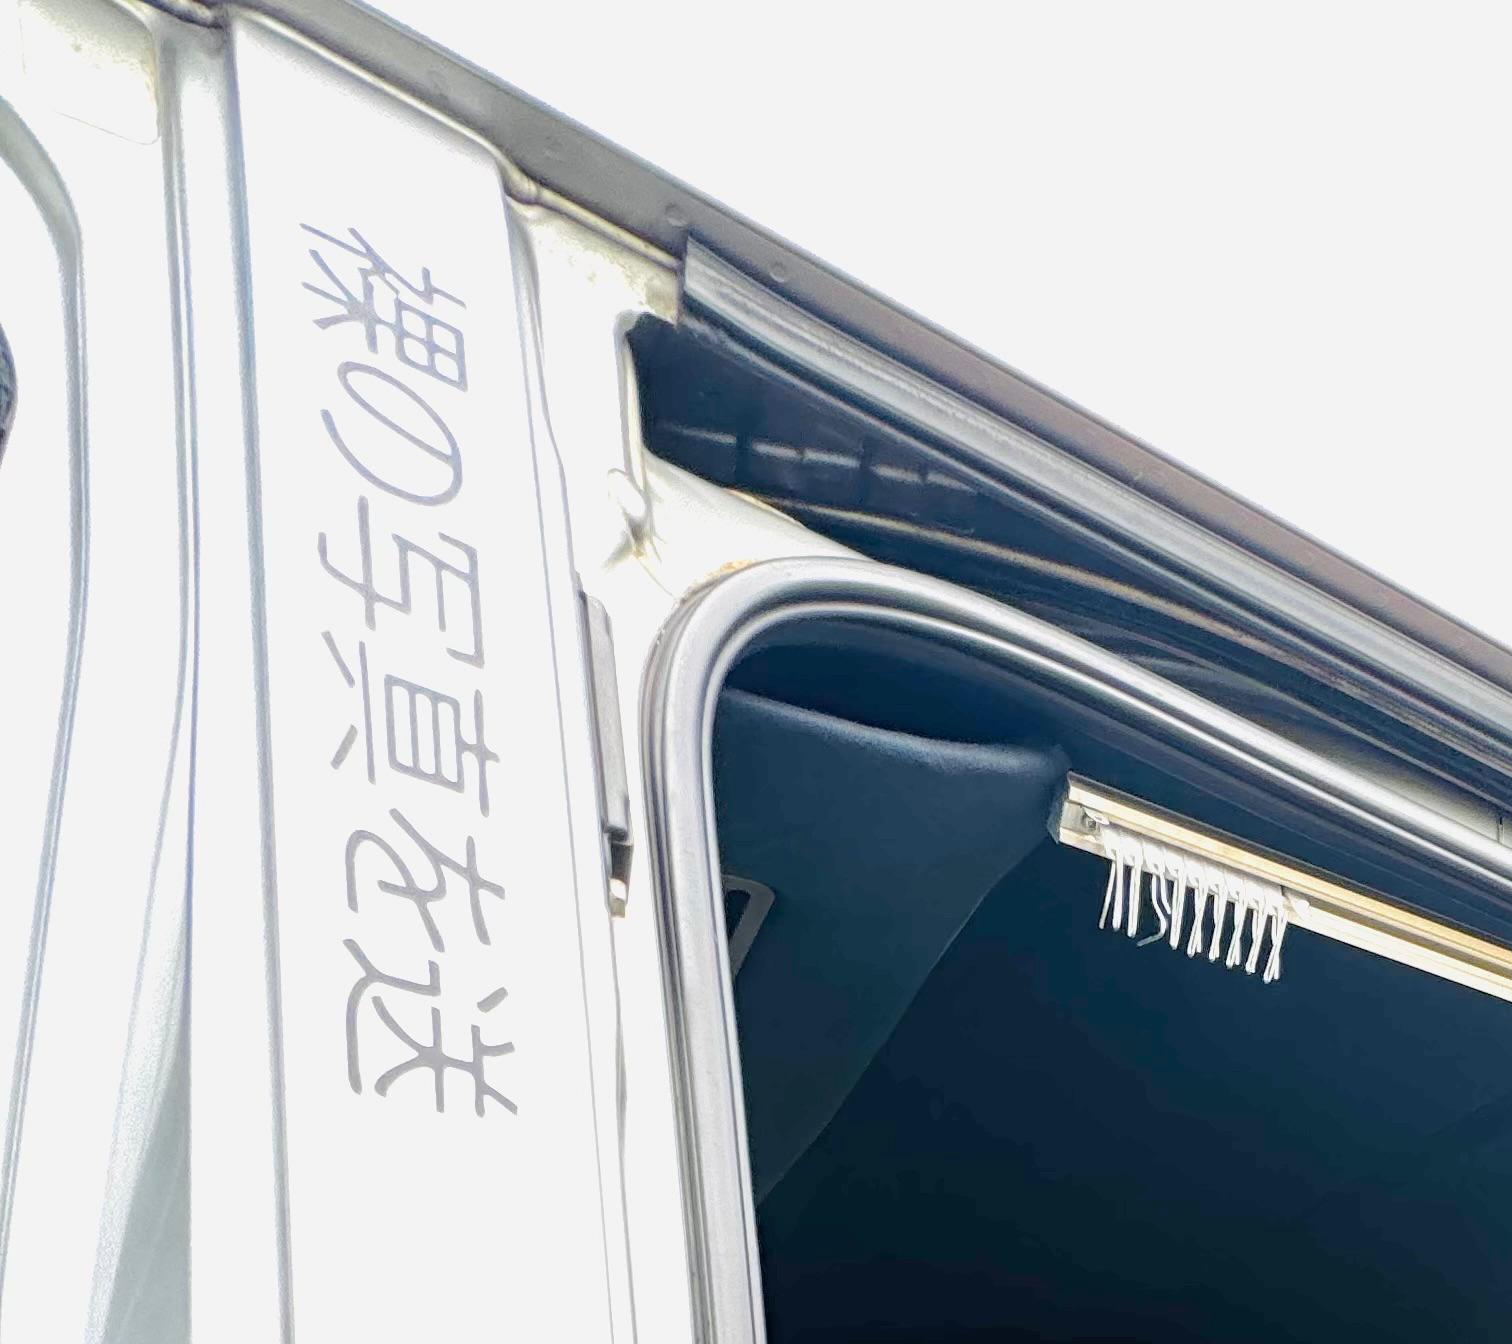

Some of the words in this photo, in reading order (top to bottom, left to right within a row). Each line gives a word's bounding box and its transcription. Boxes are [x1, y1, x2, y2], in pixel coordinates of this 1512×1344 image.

[298, 222, 518, 1119] 裸の写真を送
